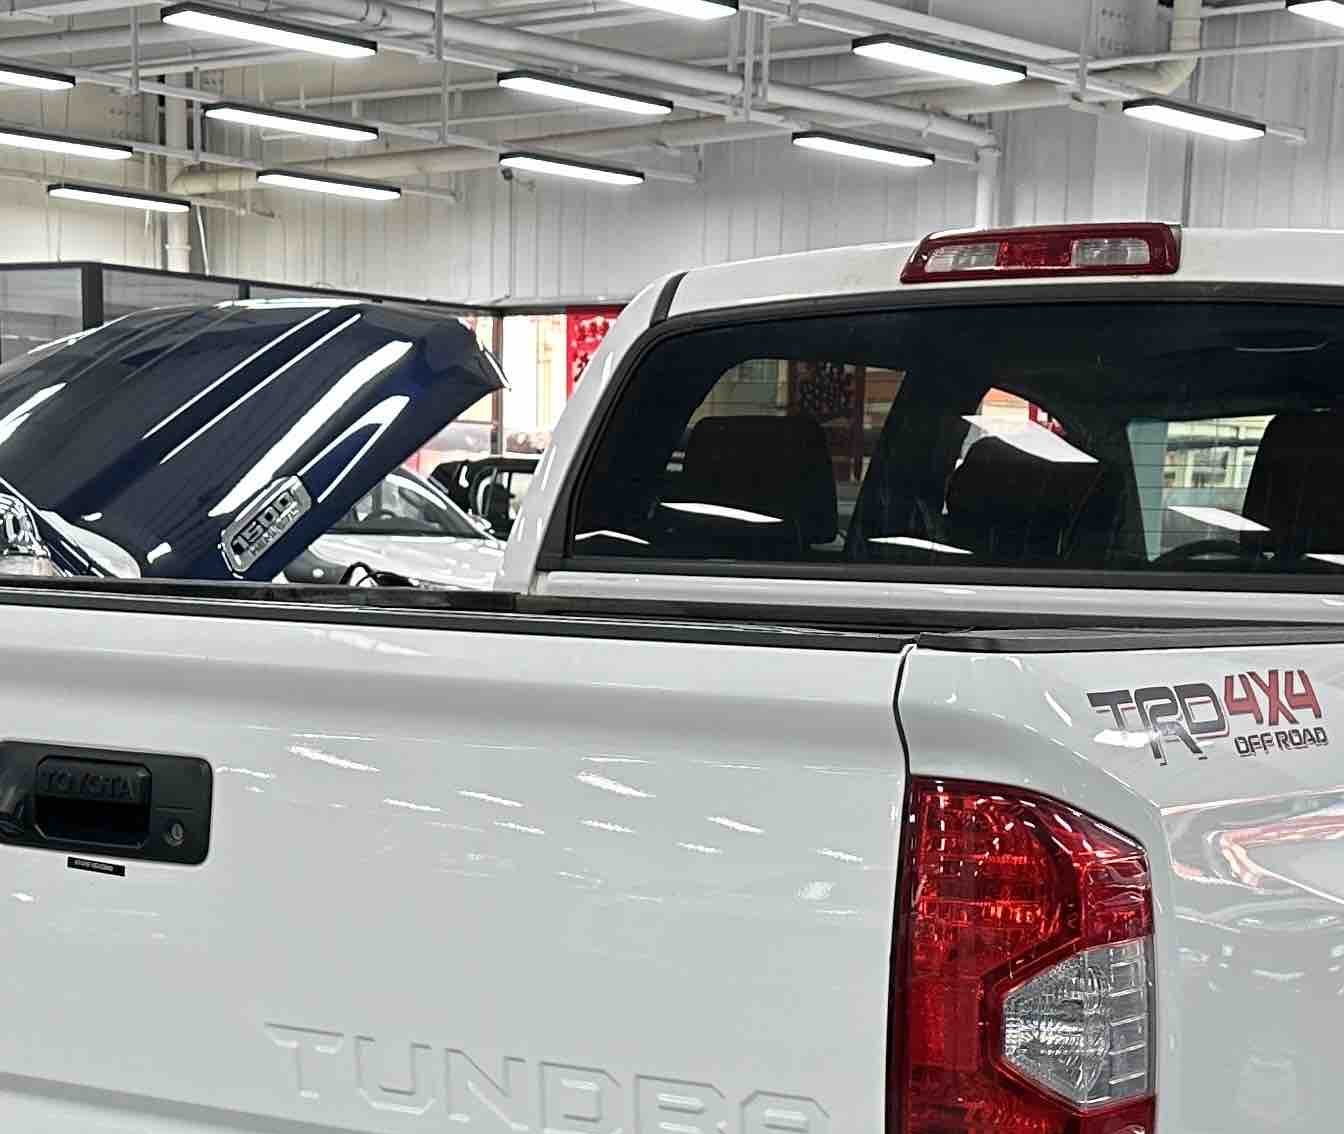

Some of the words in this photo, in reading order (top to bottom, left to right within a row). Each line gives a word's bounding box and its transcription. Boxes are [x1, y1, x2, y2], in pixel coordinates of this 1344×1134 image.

[231, 490, 294, 554] 1500
[1086, 682, 1230, 766] TRD
[1223, 669, 1324, 727] 4X4
[1234, 732, 1277, 758] OFF
[1276, 726, 1330, 752] ROAD
